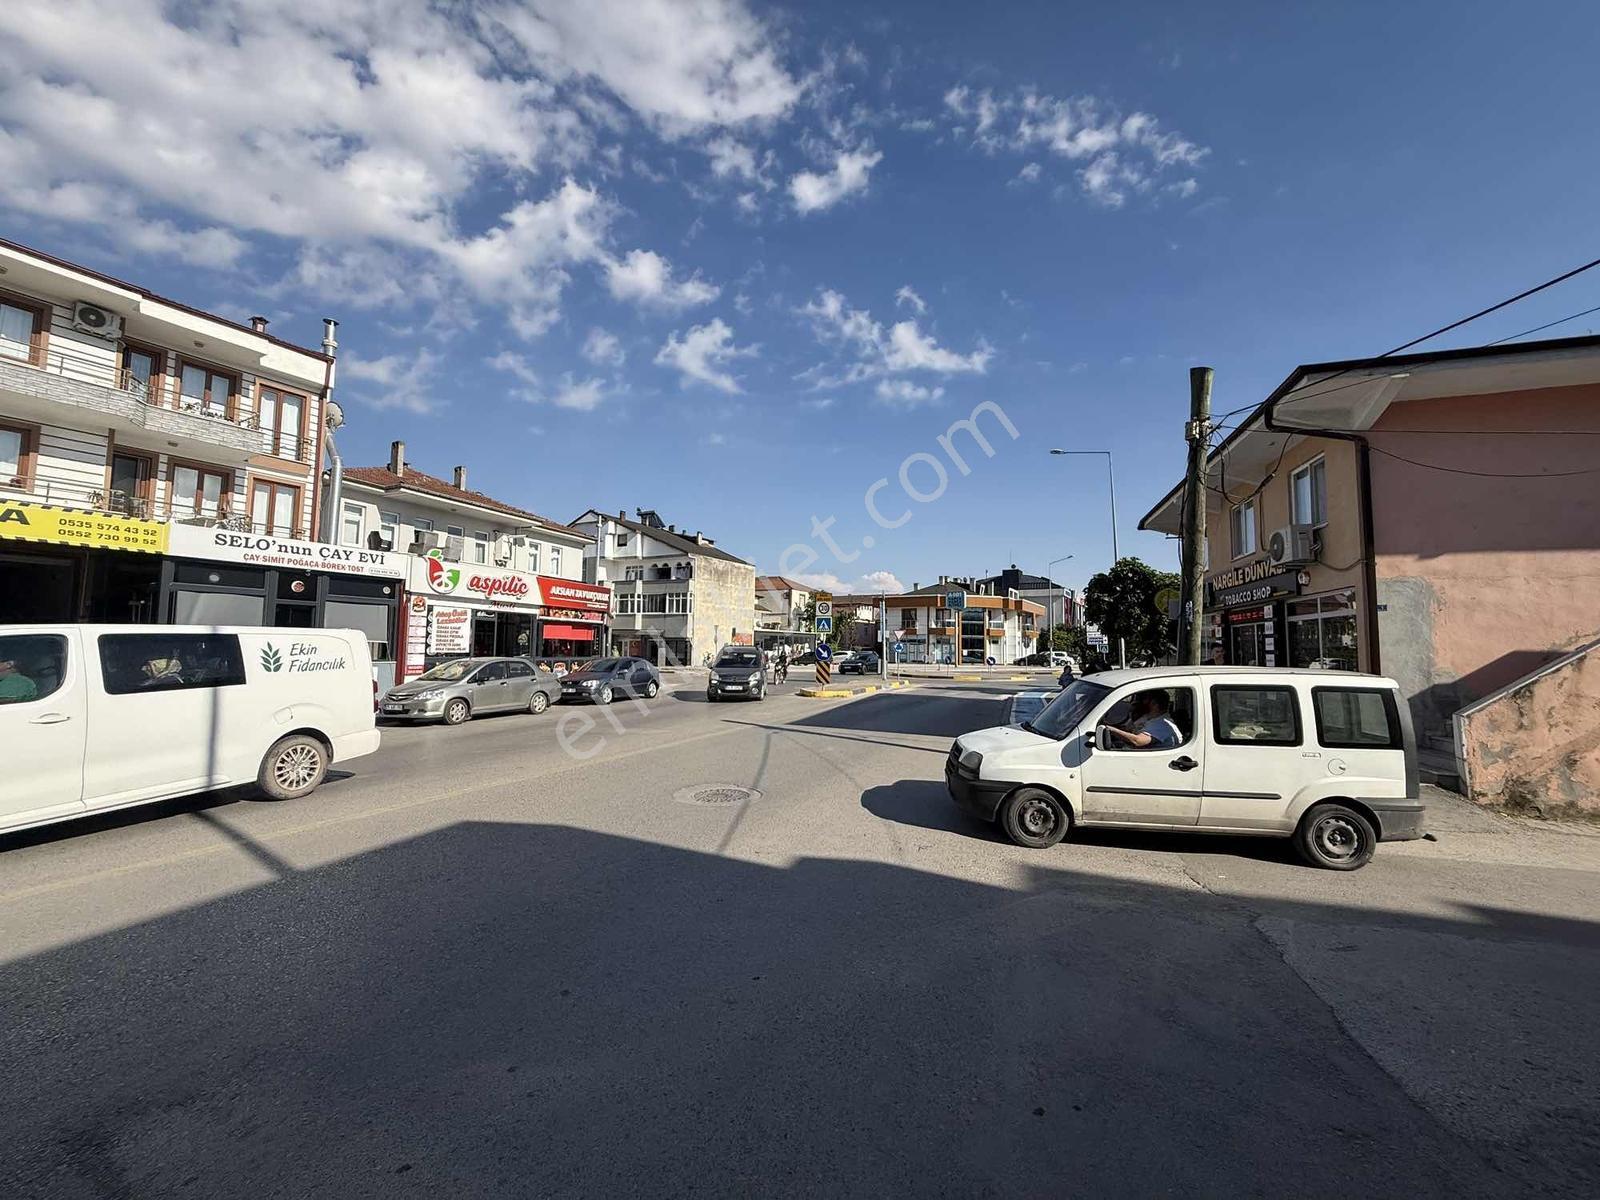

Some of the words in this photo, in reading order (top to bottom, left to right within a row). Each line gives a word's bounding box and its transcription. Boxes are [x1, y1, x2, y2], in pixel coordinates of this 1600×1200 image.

[59, 518, 92, 529] 0535
[97, 523, 120, 532] 574
[143, 529, 157, 537] 52
[58, 529, 92, 538] 0552
[97, 533, 120, 542] 730
[124, 536, 138, 544] 99
[142, 538, 157, 546] 52
[214, 533, 312, 556] SELO'nun
[318, 547, 353, 561] ÇAY
[359, 552, 385, 565] EVİ
[467, 575, 529, 600] aspiliç
[1213, 569, 1244, 591] NARGİLE
[1225, 591, 1251, 605] TOBACCO
[1252, 586, 1271, 600] SHOP
[289, 643, 318, 656] Ekin
[288, 657, 346, 672] Fidancılık
